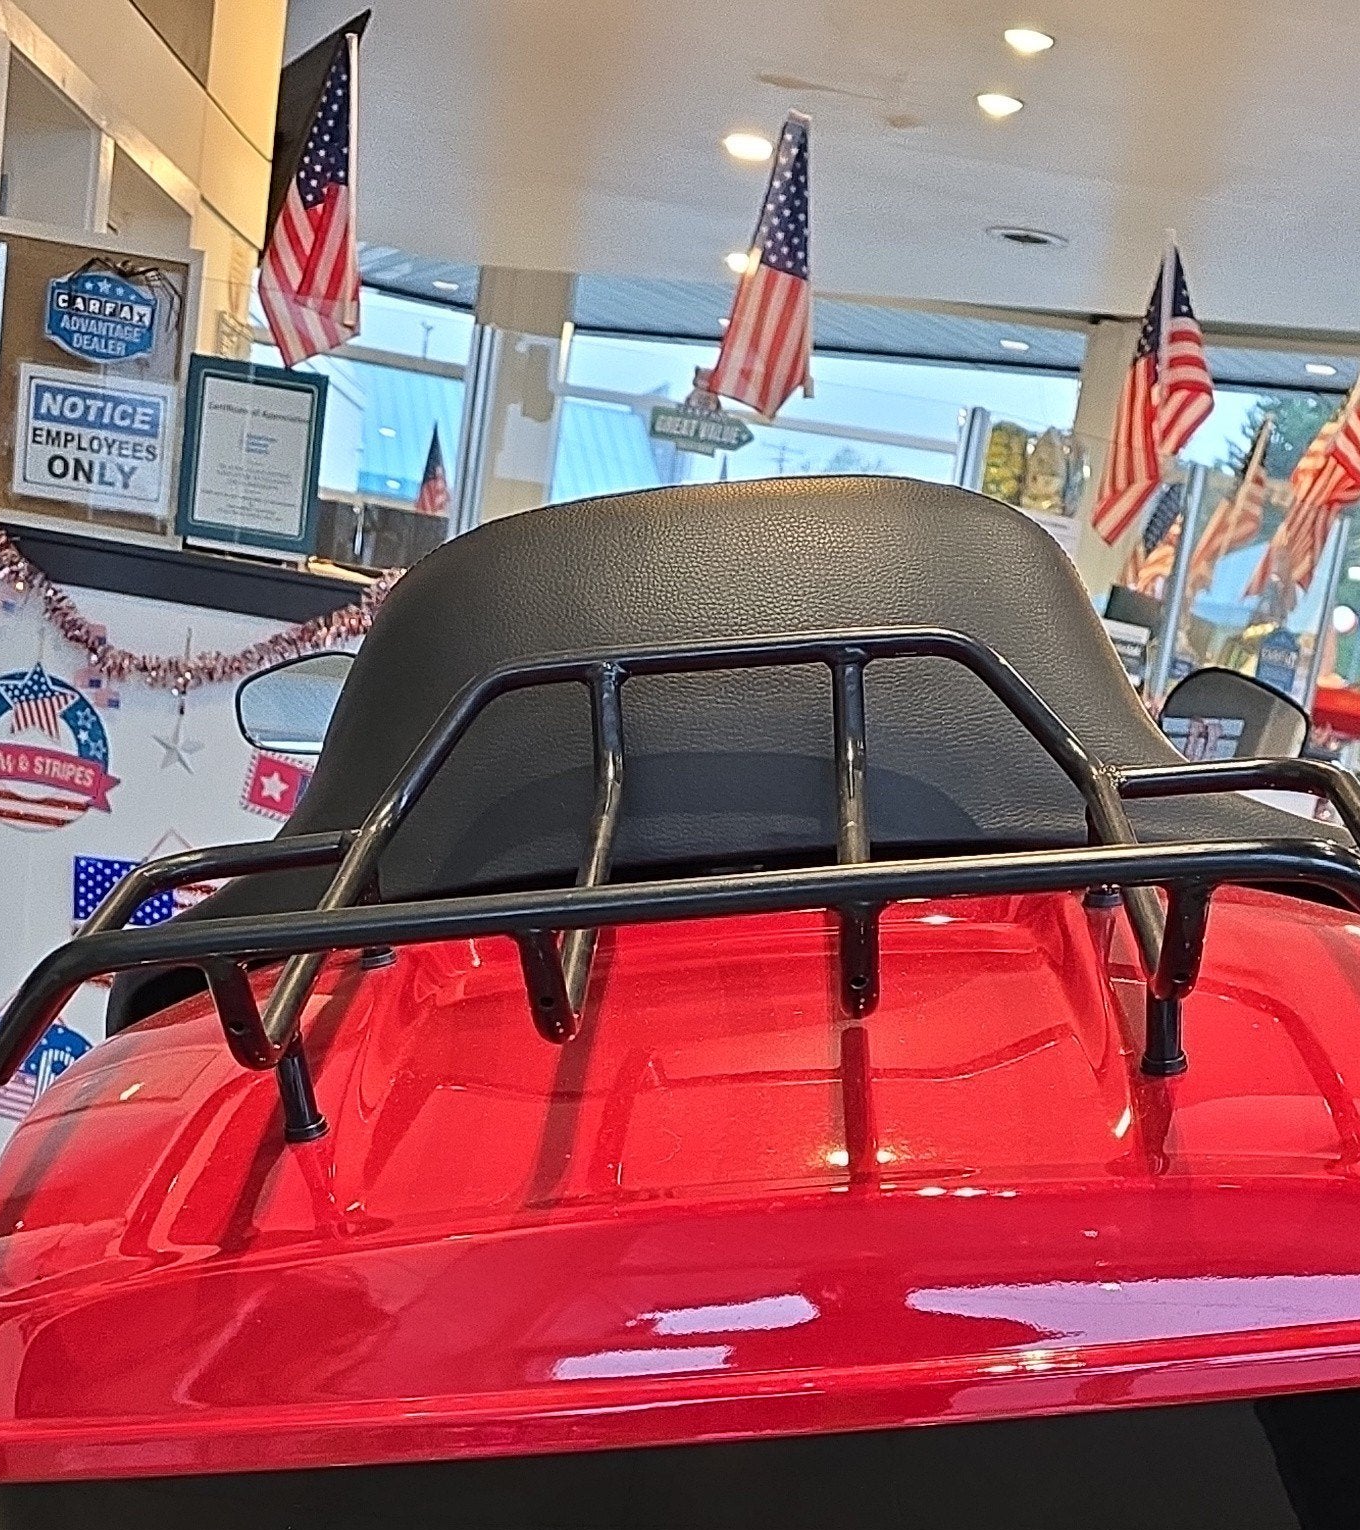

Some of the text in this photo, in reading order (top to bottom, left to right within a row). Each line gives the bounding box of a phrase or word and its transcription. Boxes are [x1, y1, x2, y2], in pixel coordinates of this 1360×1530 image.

[57, 293, 151, 327] CARFAX
[60, 314, 143, 342] ADVANTAGE
[72, 333, 127, 356] DEALER
[40, 391, 154, 430] NOTICE
[32, 427, 158, 462] EMPLOYEES
[47, 454, 138, 490] ONLY
[33, 755, 95, 787] STRIPES
